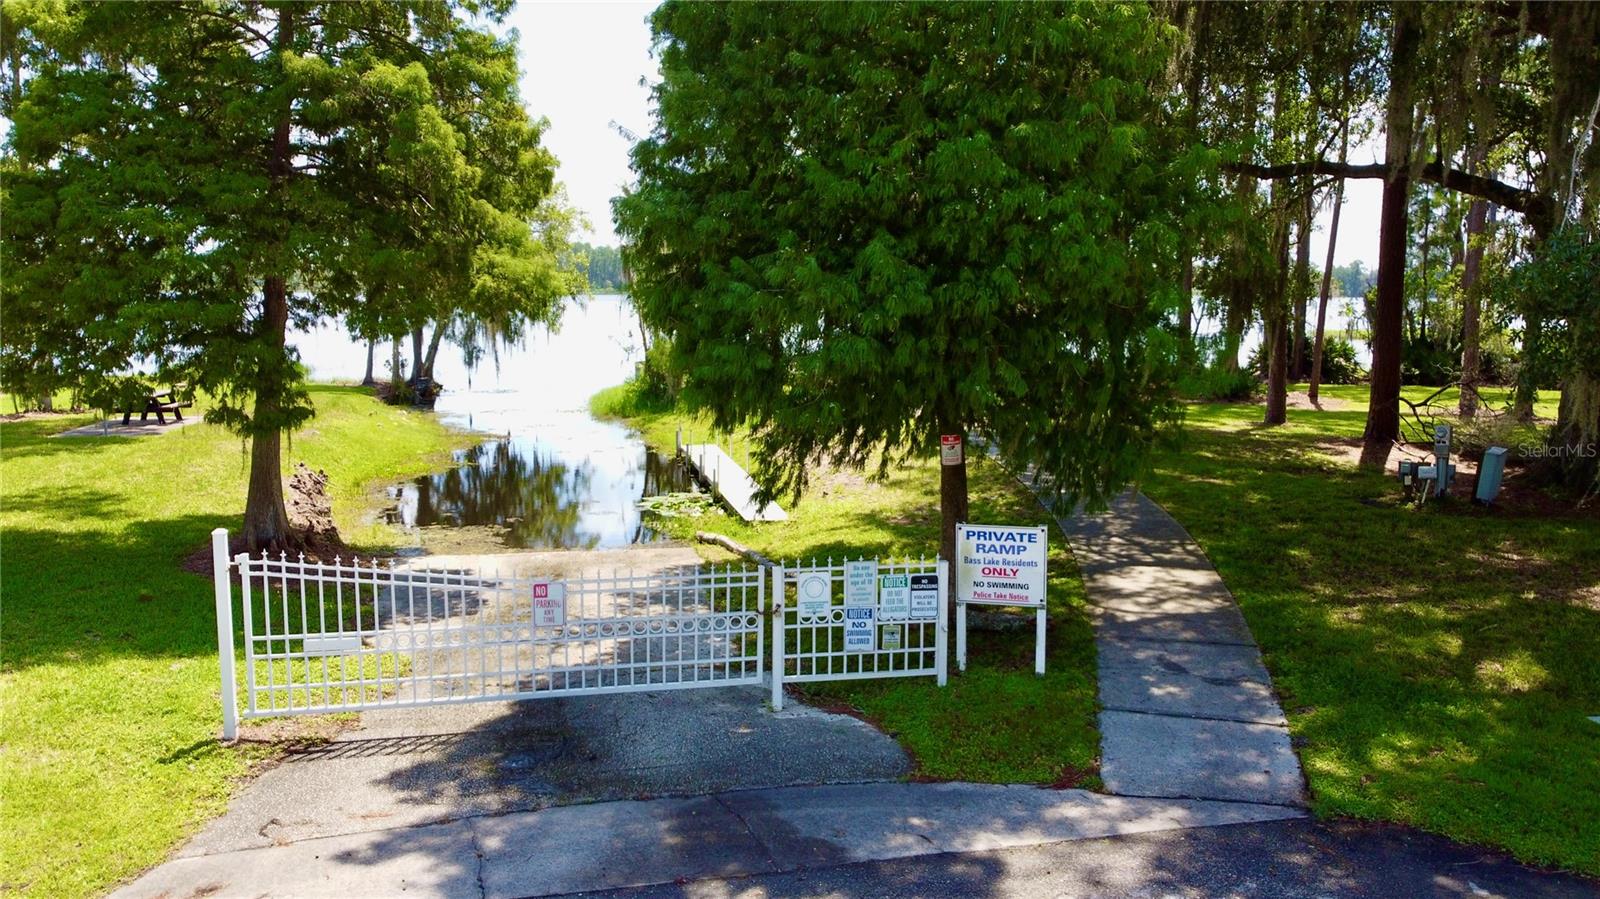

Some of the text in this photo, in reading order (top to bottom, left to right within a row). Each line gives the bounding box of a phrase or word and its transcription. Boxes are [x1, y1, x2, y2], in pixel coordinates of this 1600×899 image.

[966, 530, 1037, 543] PRIVATE
[976, 543, 1027, 555] RAMP
[963, 556, 1038, 567] Bass Lake Residents
[981, 567, 1019, 577] ONLY
[884, 577, 906, 588] NOTICE
[986, 581, 1029, 590] SWIMMING
[535, 585, 546, 597] NO
[973, 591, 991, 599] Police
[1008, 592, 1029, 600] Notice
[536, 600, 561, 608] PARKING
[848, 608, 870, 619] NOTICE
[852, 621, 867, 629] NO
[848, 637, 870, 645] ALLOWED
